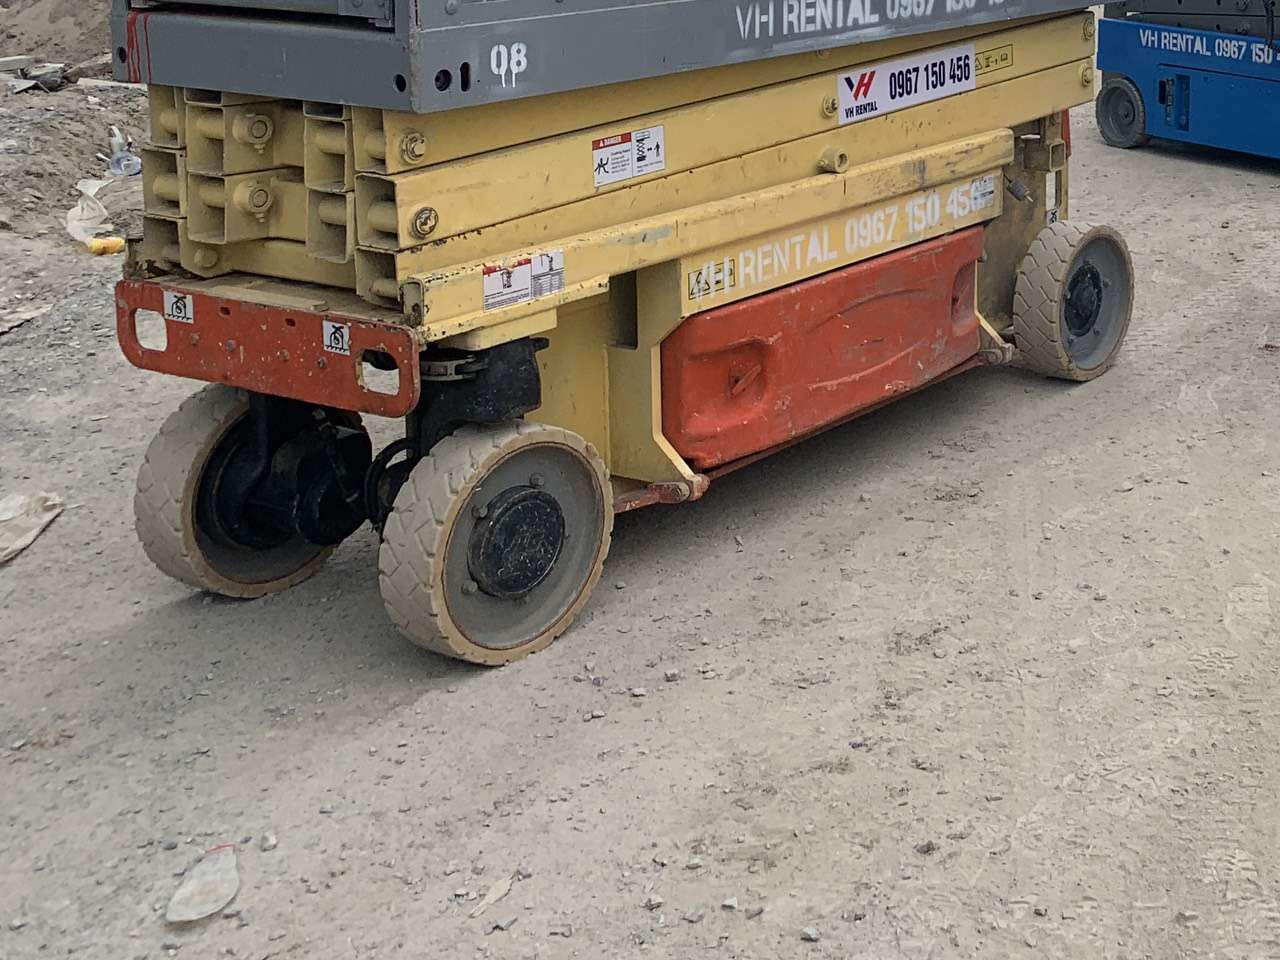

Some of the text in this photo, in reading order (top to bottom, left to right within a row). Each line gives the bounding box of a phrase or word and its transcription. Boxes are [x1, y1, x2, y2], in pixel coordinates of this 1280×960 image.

[735, 0, 774, 40] VH
[1139, 29, 1158, 48] VH
[1161, 32, 1211, 56] RENTAL
[1215, 39, 1247, 61] 0967
[1250, 43, 1273, 64] 150
[889, 54, 971, 100] 0967 150 456
[844, 101, 878, 119] VH RENTAL
[738, 227, 838, 289] RENTAL
[844, 206, 898, 253] 0967
[905, 194, 940, 233] 150
